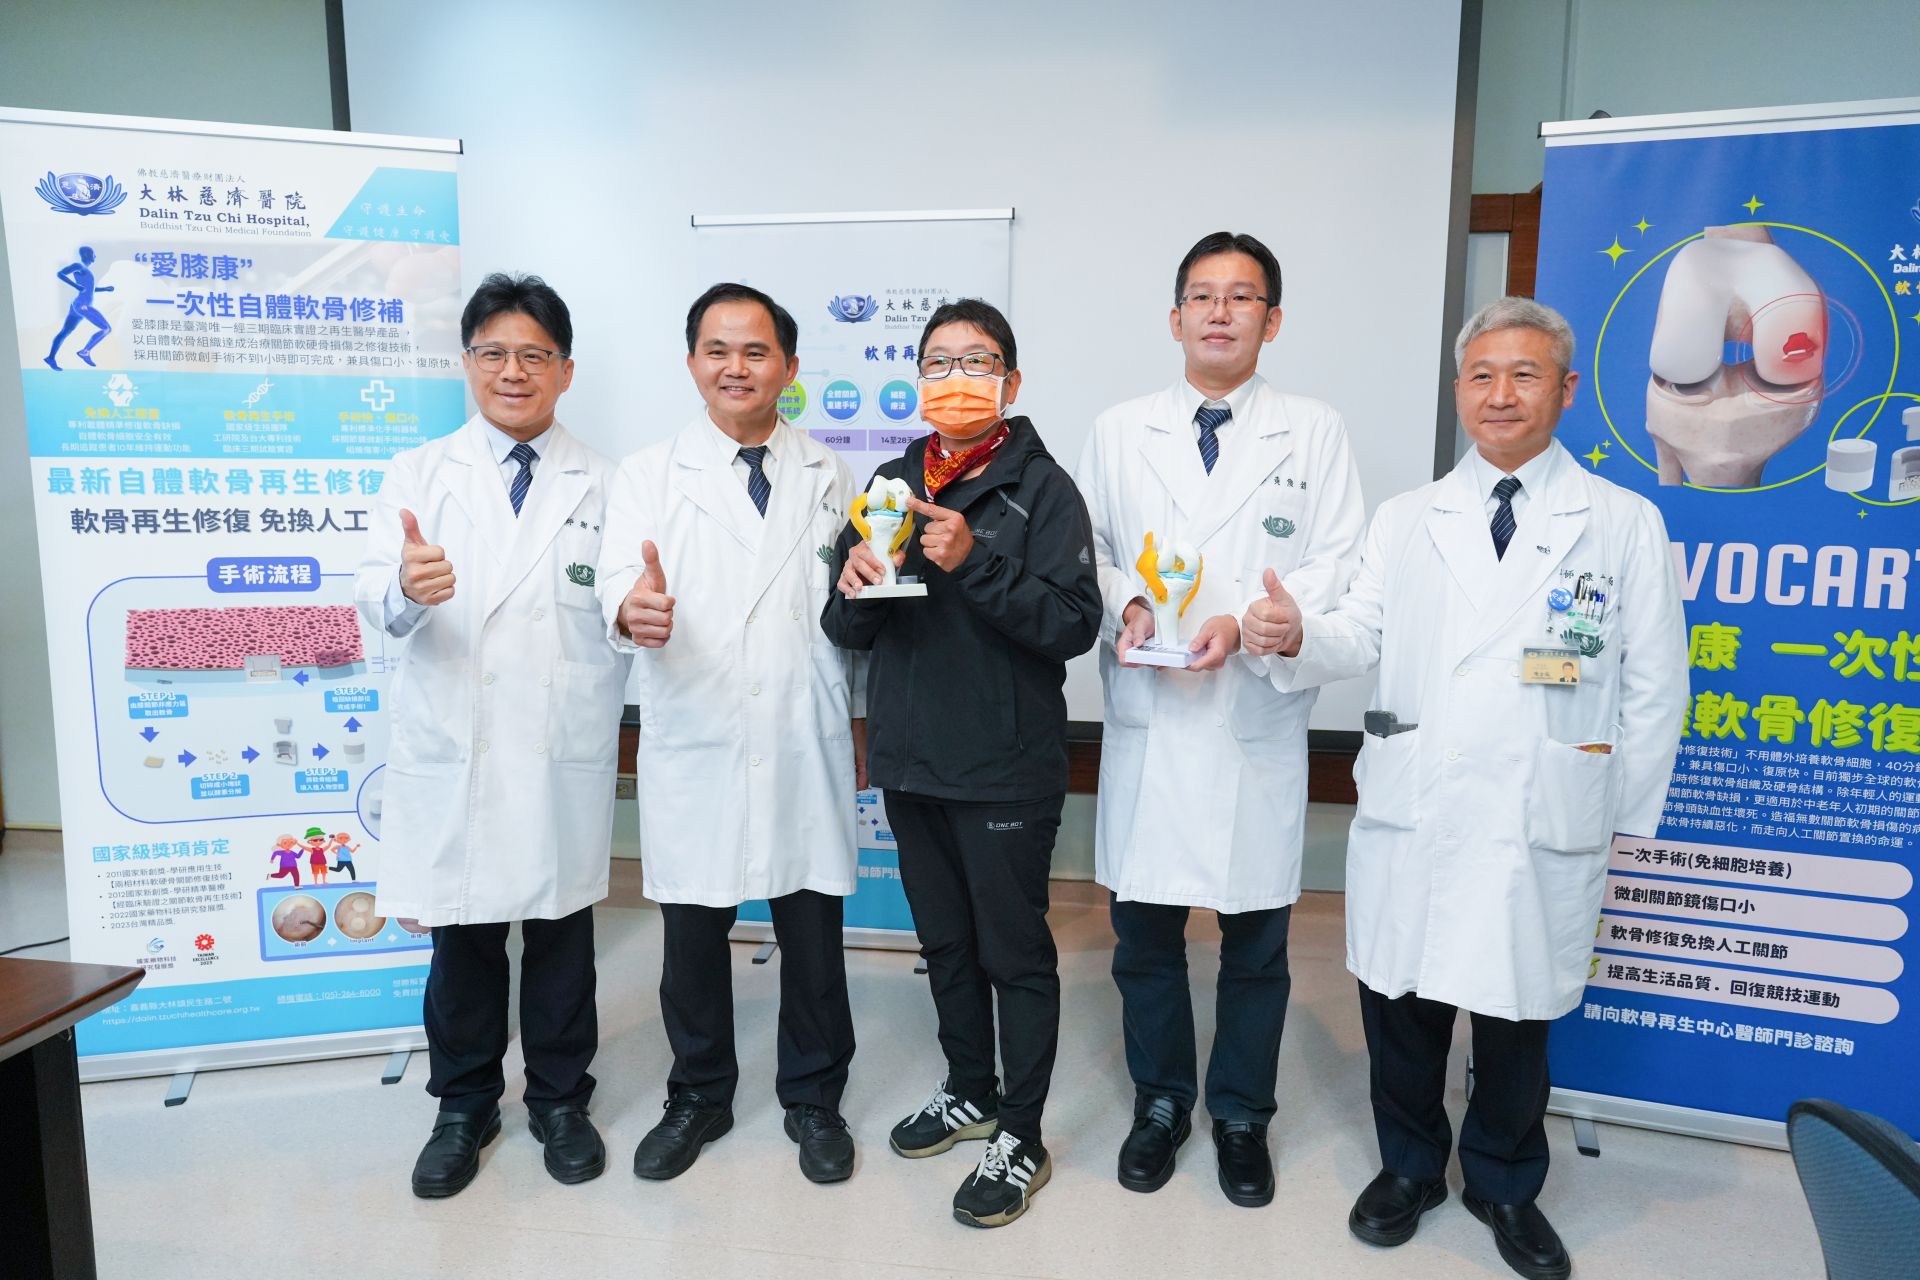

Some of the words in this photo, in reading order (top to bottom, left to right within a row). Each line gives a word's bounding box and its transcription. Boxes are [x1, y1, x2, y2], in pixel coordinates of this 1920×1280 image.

[139, 183, 306, 211] 大林慈濟醫院
[139, 207, 178, 220] Dalin
[184, 210, 212, 222] Tzu
[217, 212, 241, 223] Chi
[247, 214, 310, 228] Hospital,
[140, 221, 183, 231] Buddhist
[186, 223, 203, 232] Tzu
[206, 224, 222, 233] Chi
[225, 226, 259, 235] Medical
[262, 228, 312, 238] Foundation
[146, 290, 404, 323] 一次性自體軟骨修補
[885, 314, 908, 322] Dalin
[911, 314, 927, 322] Tzu
[825, 436, 851, 444] 60分鐘
[881, 436, 915, 444] 14至28天
[47, 466, 386, 496] 最新自體軟骨再生修復
[70, 507, 252, 535] 軟骨再生修復
[260, 507, 369, 534] 免換人工
[218, 563, 313, 585] 手術流程
[1669, 541, 1920, 610] VOCAR
[1688, 621, 1743, 672] 康
[140, 692, 166, 700] STEP
[1681, 689, 1920, 755] 軟骨修復
[203, 772, 228, 781] STEP
[306, 767, 329, 775] STEP
[92, 838, 231, 863] 國家級獎項肯定
[1617, 847, 1793, 880] 一次手術(免細胞培養)
[1613, 885, 1756, 915] 微創關節鏡傷口小
[1610, 925, 1789, 960] 軟骨修復免換人工關節
[1583, 1002, 1855, 1057] 請向軟骨再生中心醫師門診諮詢
